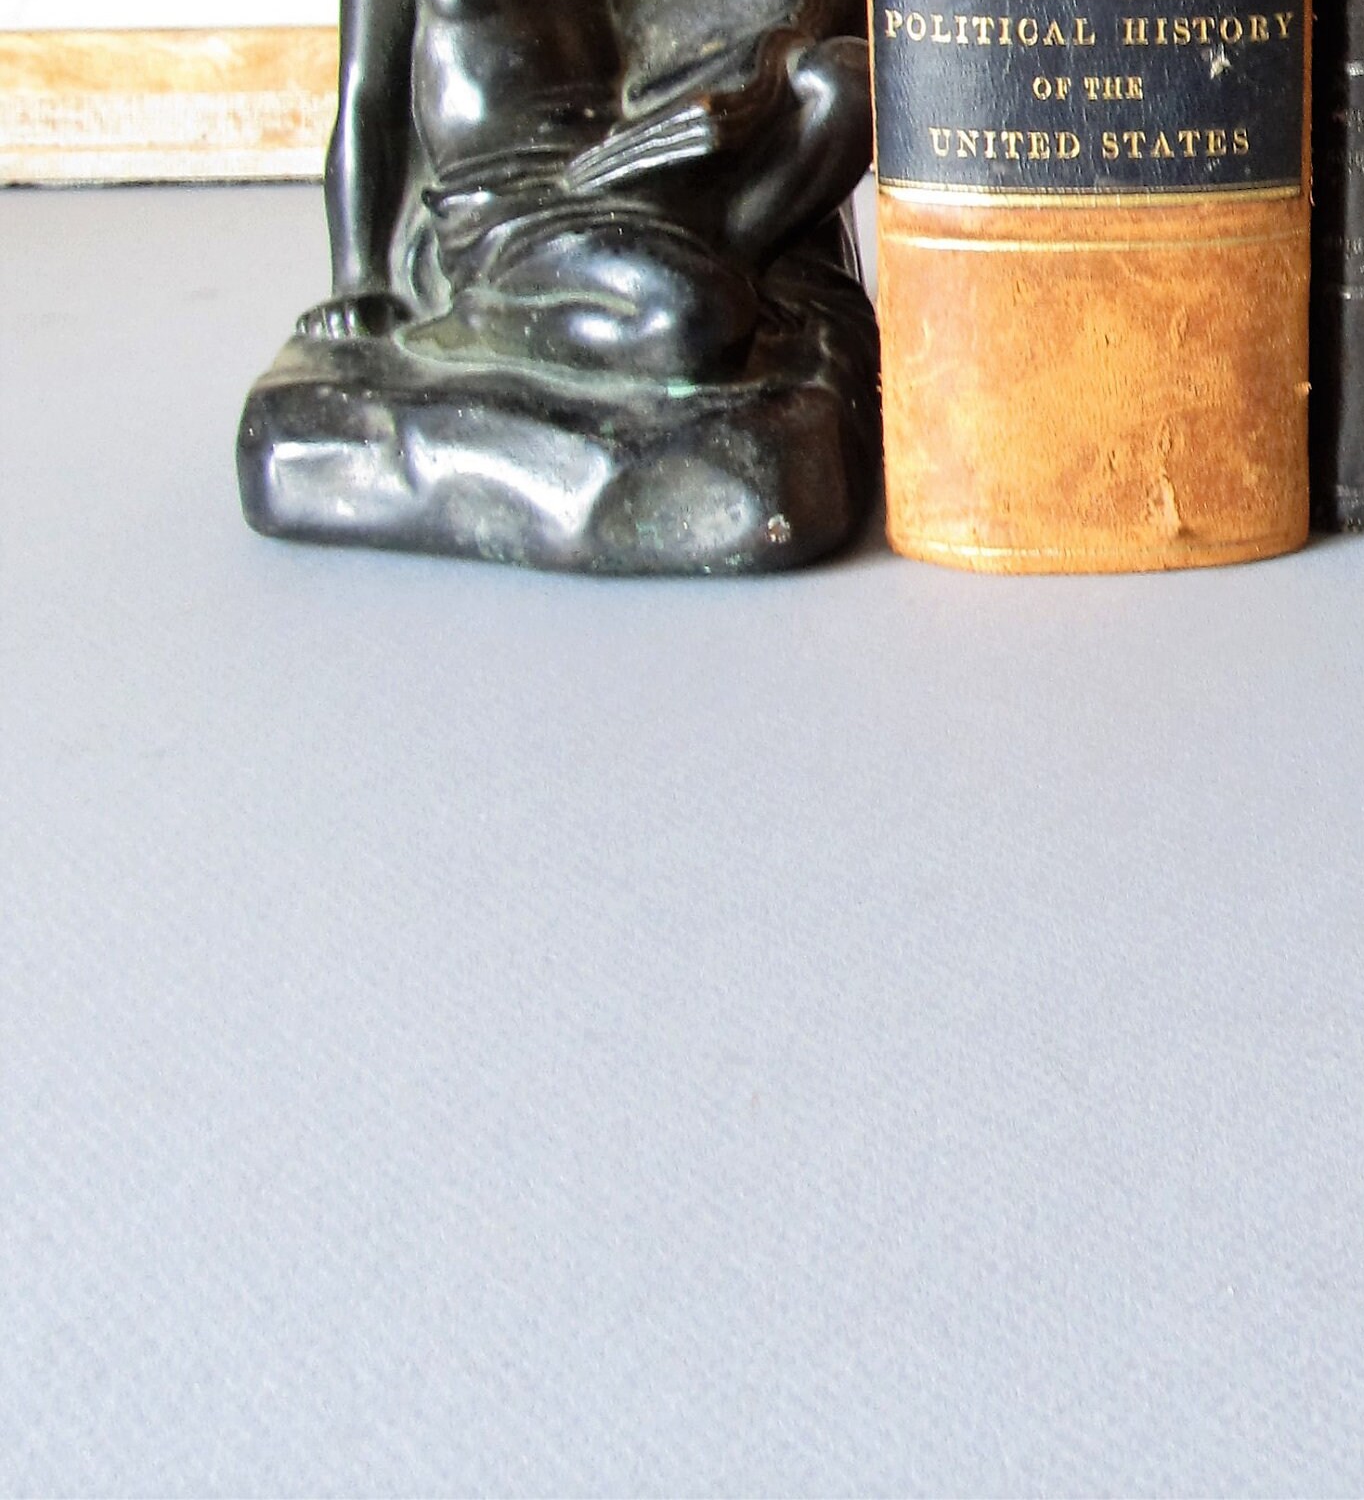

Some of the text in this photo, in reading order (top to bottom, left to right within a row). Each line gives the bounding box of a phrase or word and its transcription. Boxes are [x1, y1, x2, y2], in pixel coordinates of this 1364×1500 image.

[884, 8, 1294, 47] POLITICAL HISTORY
[1032, 76, 1144, 101] OF THE
[929, 127, 1251, 160] UNITED STATES
